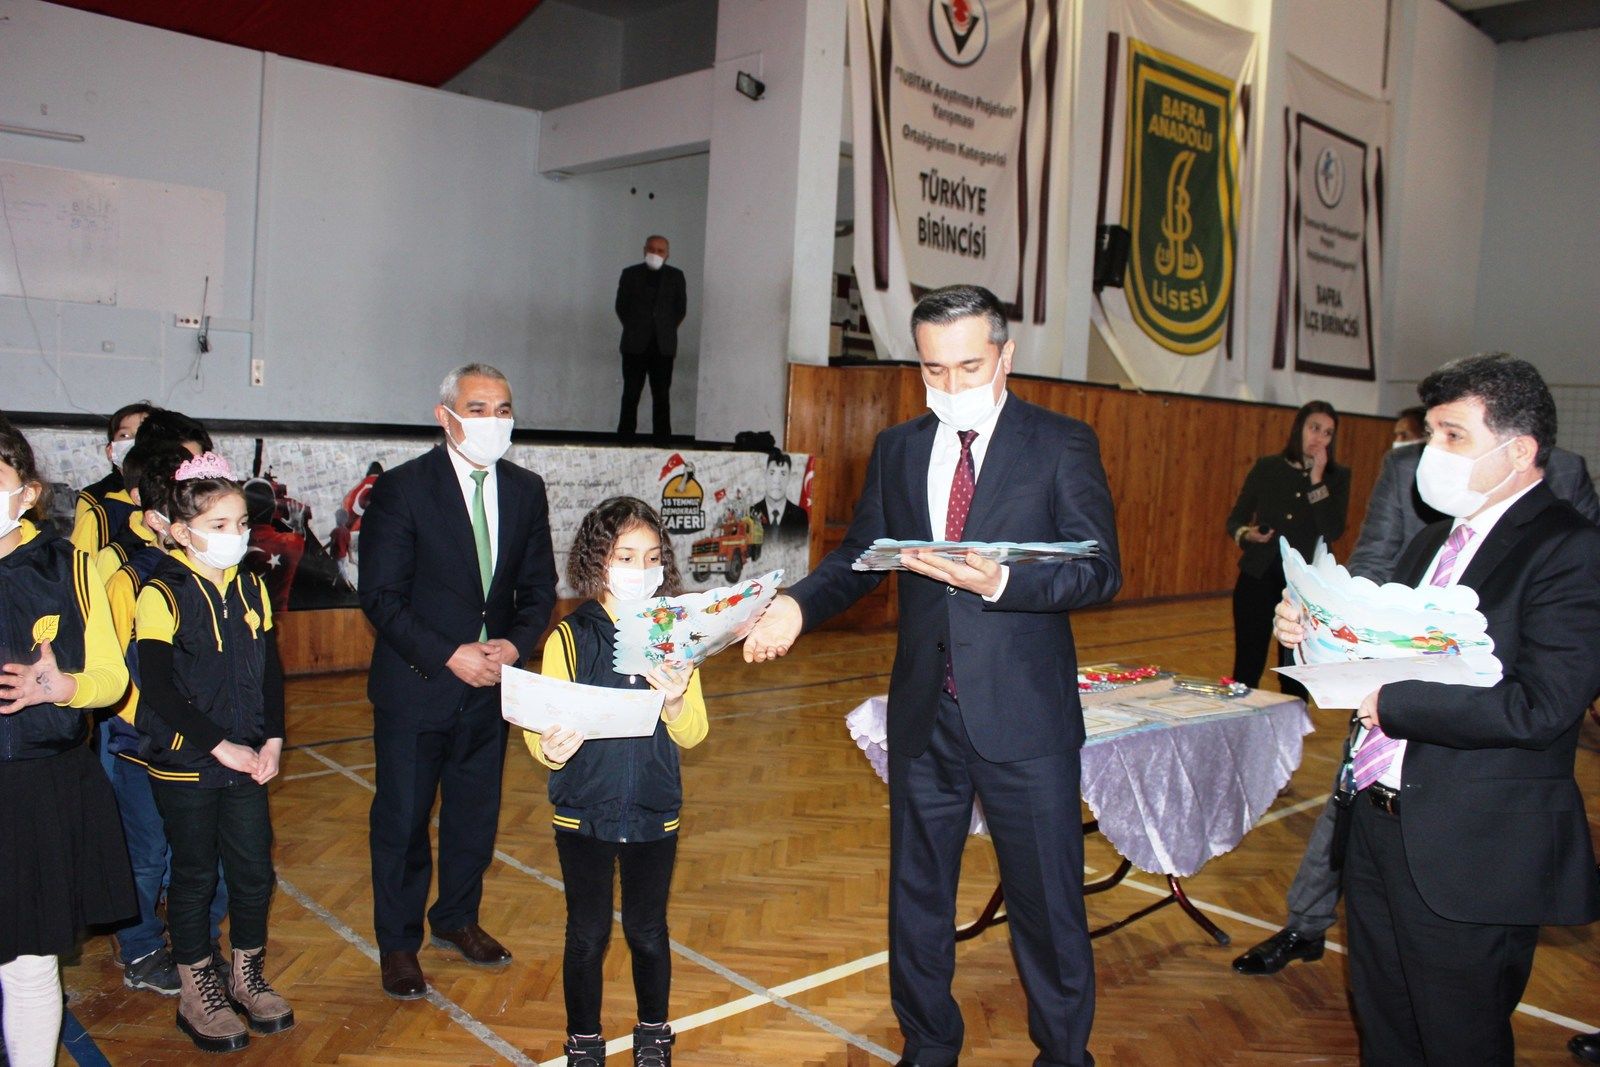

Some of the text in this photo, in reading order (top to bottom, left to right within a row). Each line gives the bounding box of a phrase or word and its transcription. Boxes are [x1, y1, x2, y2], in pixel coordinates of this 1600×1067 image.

[1161, 94, 1206, 129] BAFRA
[1148, 113, 1213, 152] ANADOLU
[919, 167, 987, 216] TÜRKİYE
[918, 211, 986, 260] BİRİNCİSİ
[1152, 279, 1209, 311] LİSESİ
[660, 512, 705, 529] ZAFERİ
